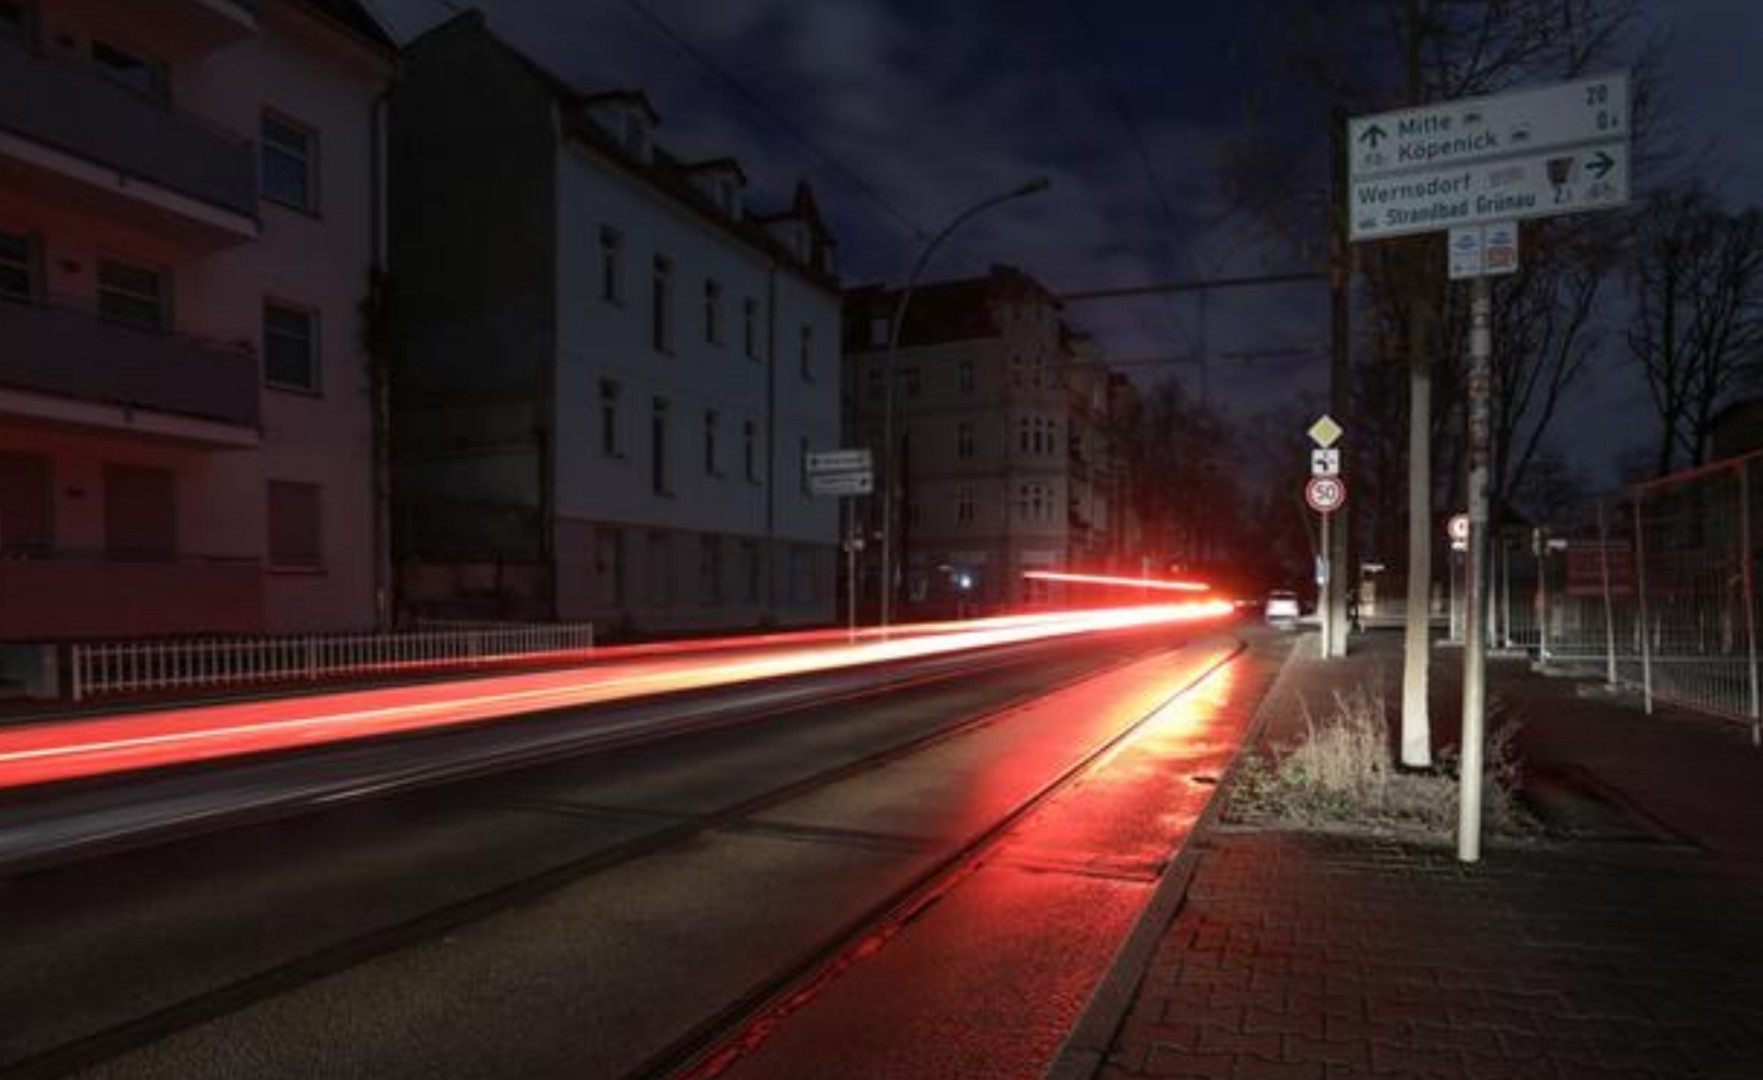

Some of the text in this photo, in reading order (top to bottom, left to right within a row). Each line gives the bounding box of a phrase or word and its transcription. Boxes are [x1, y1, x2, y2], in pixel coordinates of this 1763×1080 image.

[1586, 84, 1609, 106] 20
[1398, 114, 1452, 137] Mitte
[1398, 131, 1497, 162] Köpenick
[1358, 172, 1471, 204] Wernsdorf
[1386, 198, 1469, 226] Strandbad
[1316, 483, 1335, 500] 50
